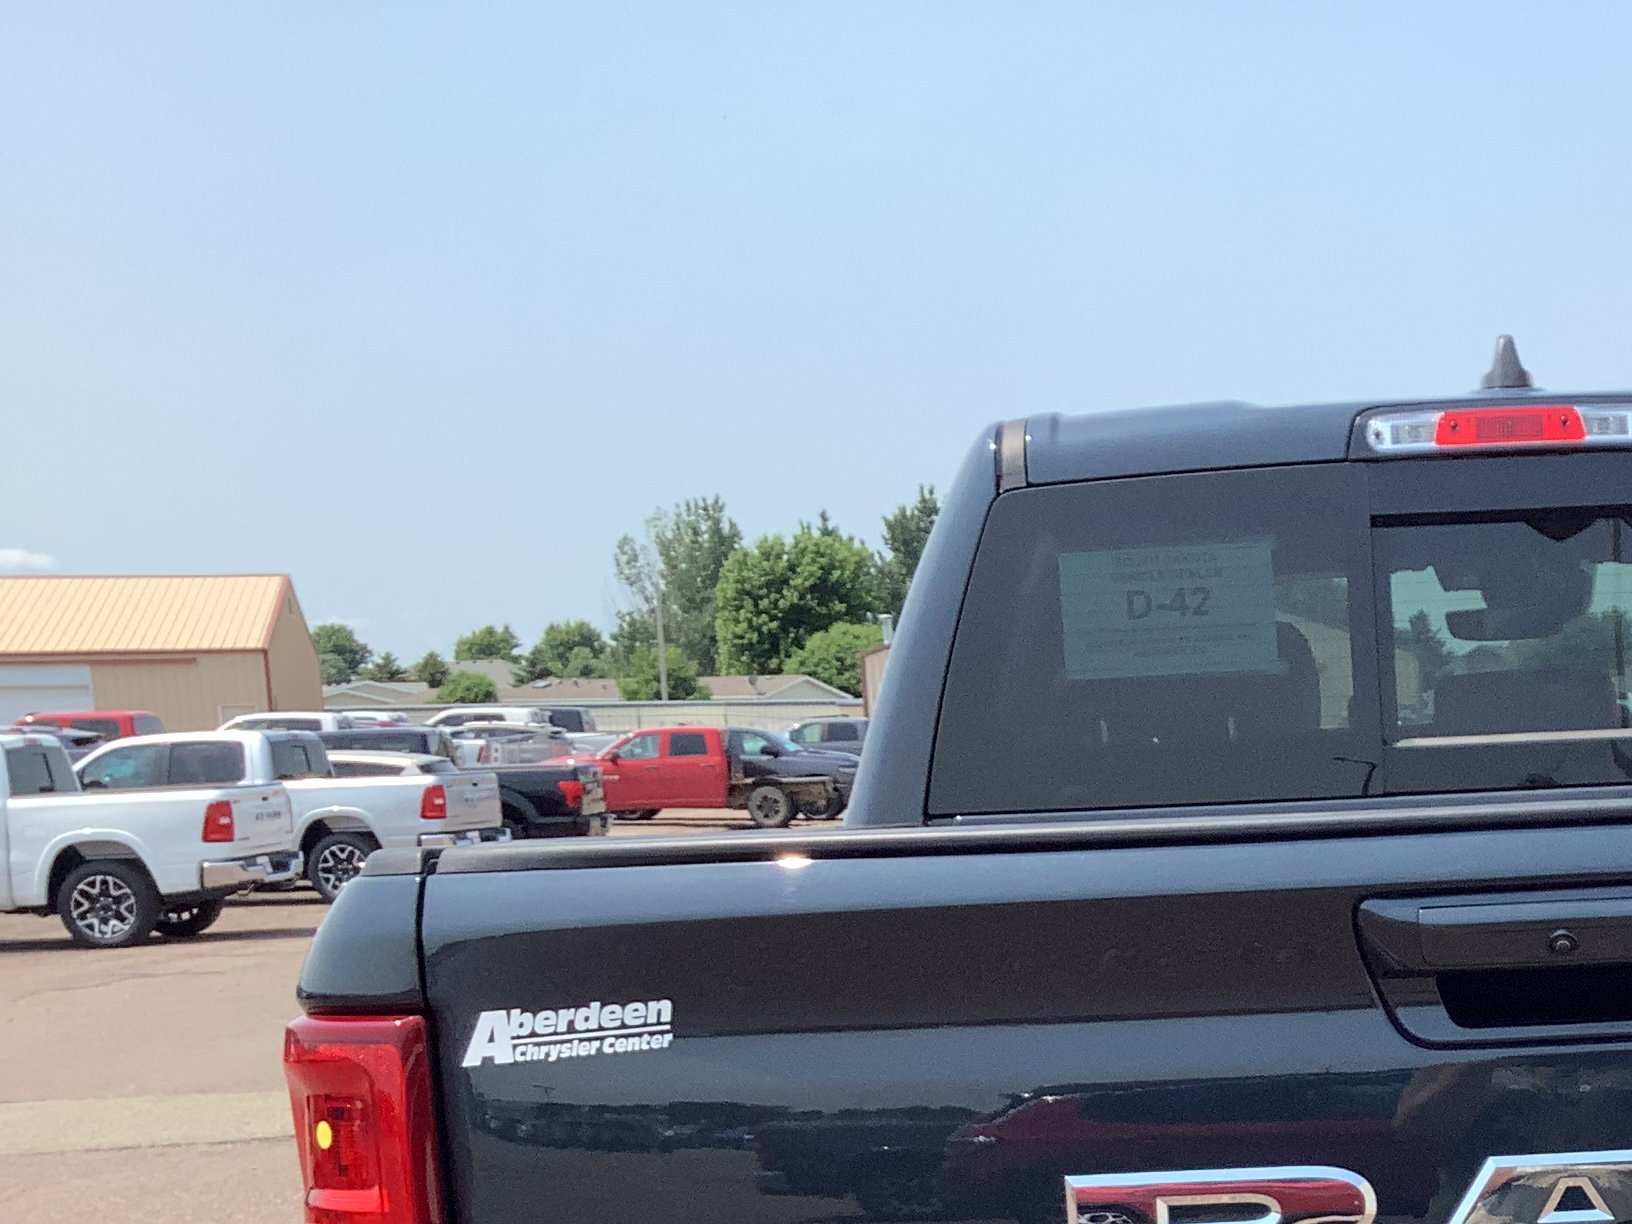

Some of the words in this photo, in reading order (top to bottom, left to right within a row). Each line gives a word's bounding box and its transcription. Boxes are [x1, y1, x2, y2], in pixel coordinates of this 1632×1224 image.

[1126, 586, 1210, 620] D-42
[462, 999, 673, 1067] Aberdeen
[514, 1038, 600, 1062] Chrysler
[602, 1033, 673, 1053] Center
